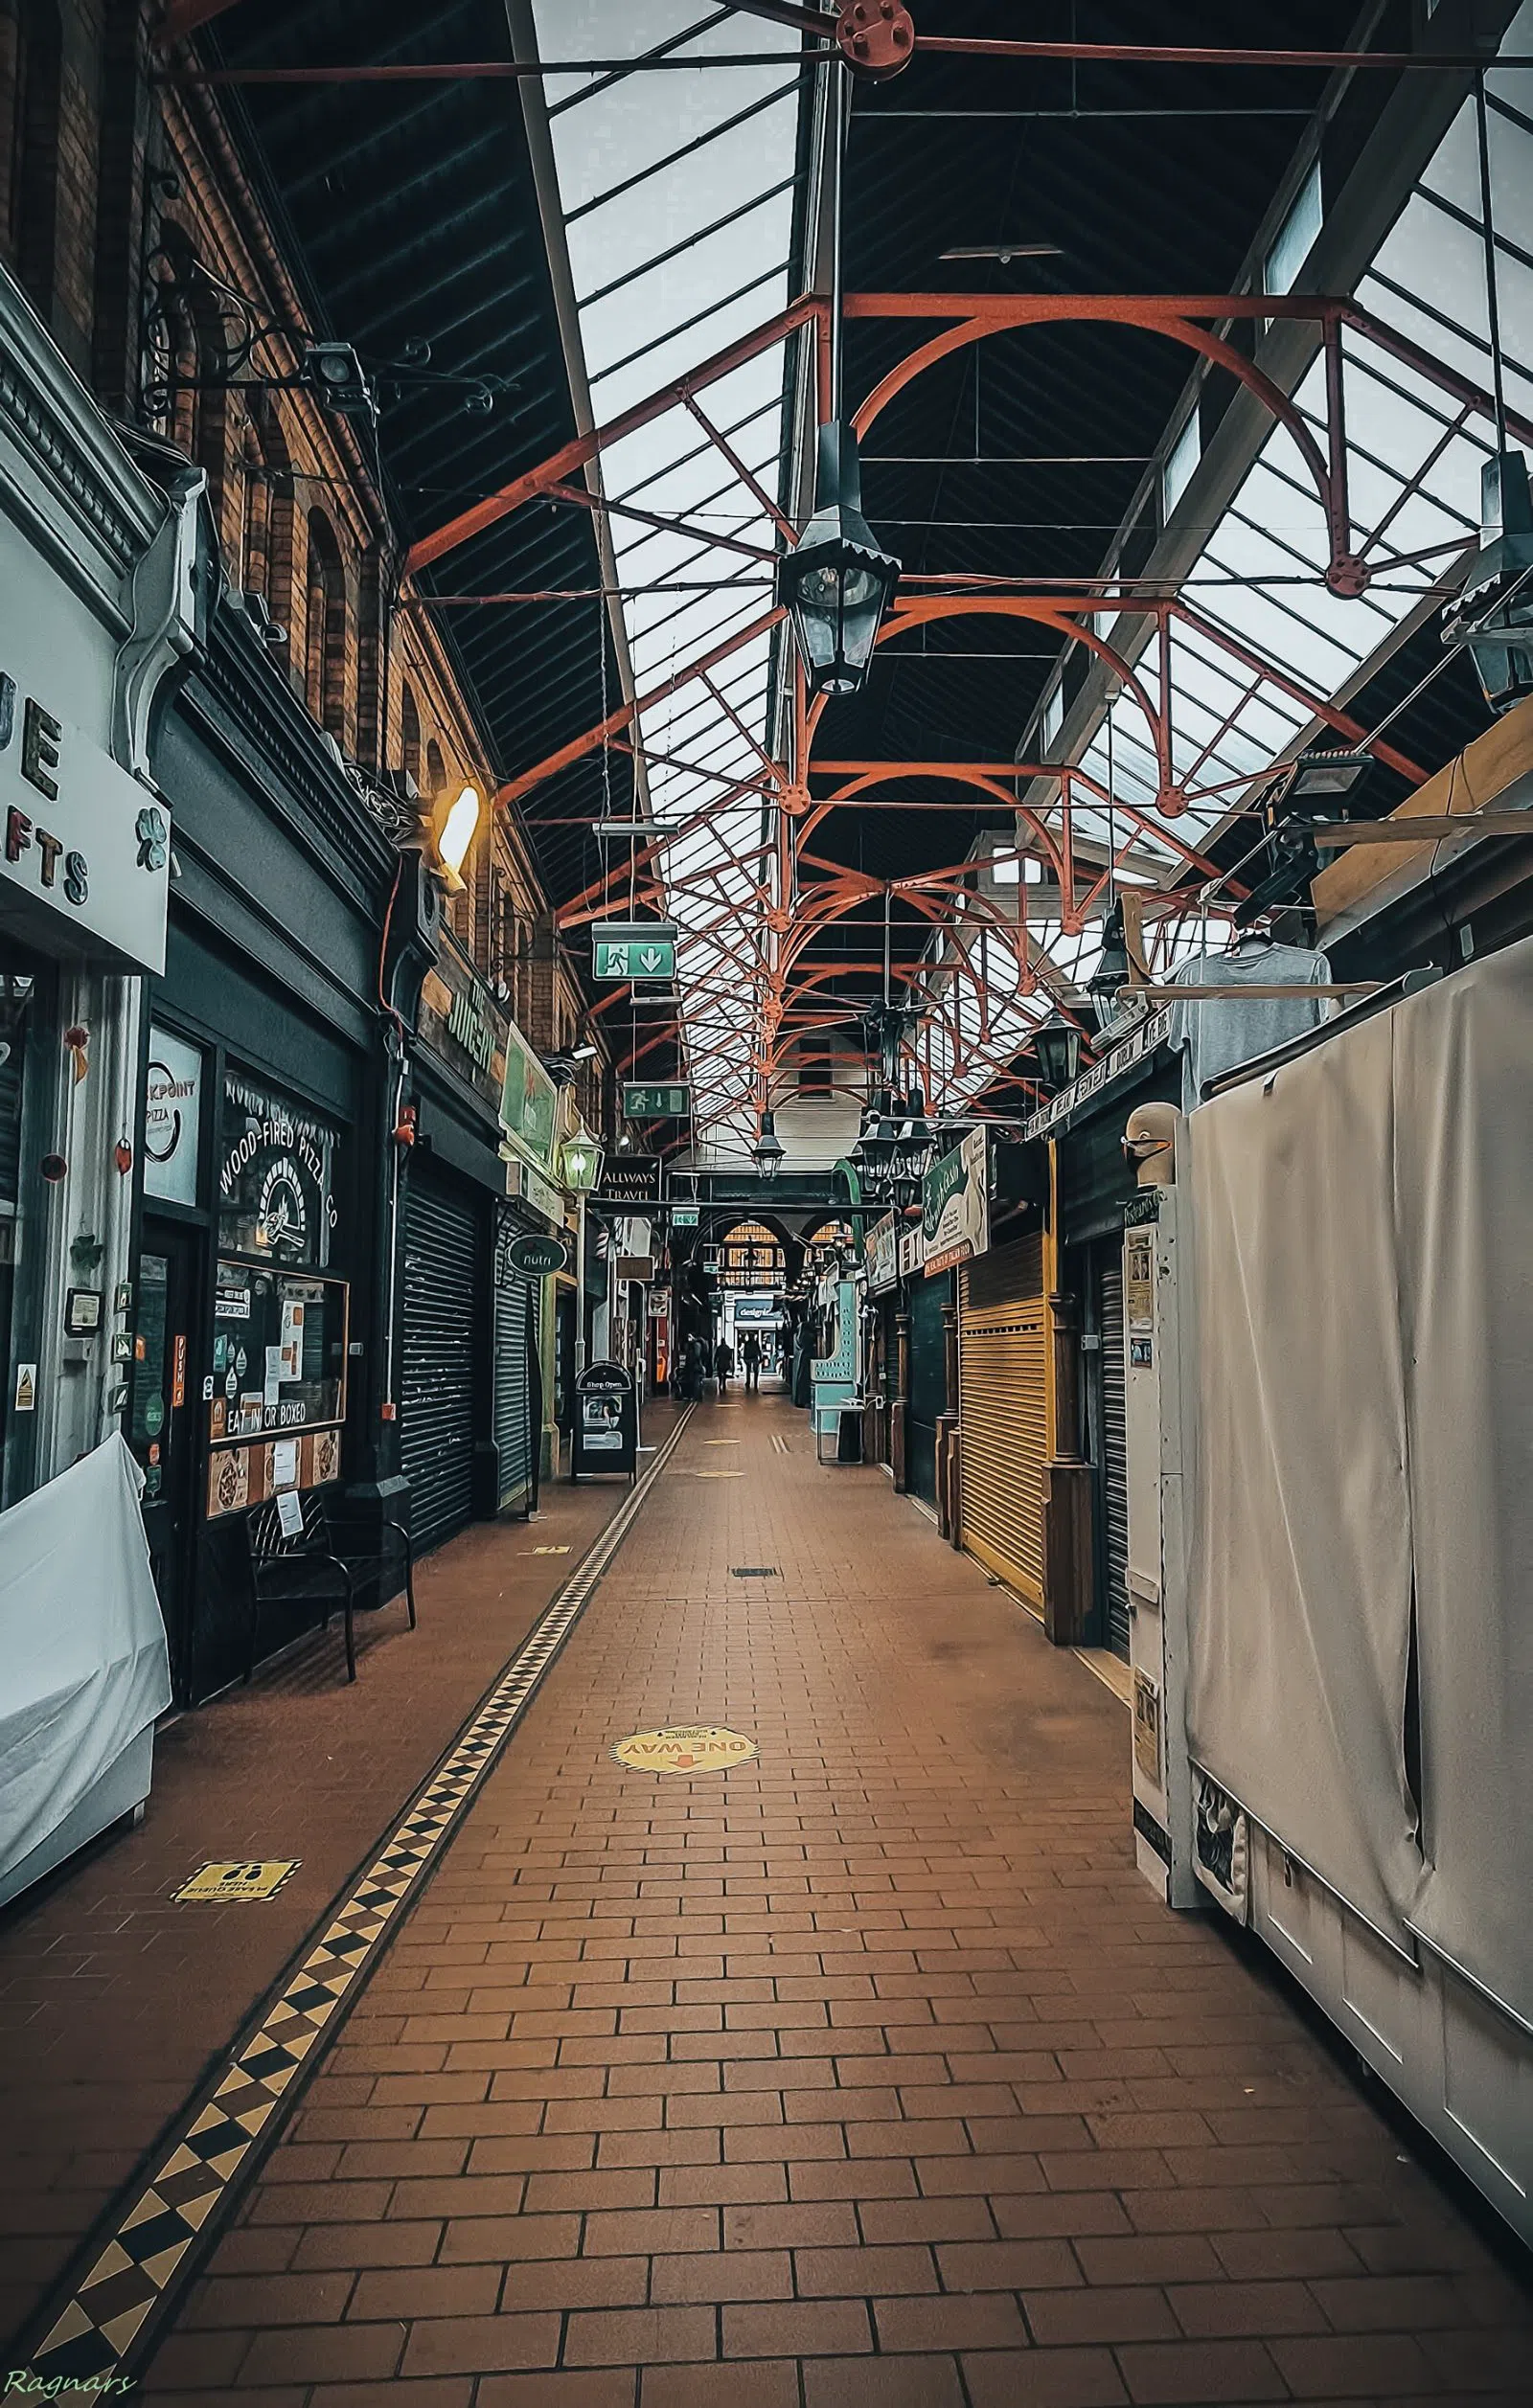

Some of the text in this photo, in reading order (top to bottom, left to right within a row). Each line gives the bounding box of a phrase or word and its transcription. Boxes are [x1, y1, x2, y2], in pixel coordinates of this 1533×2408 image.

[0, 805, 88, 904] FTS
[219, 1121, 338, 1229] WOOD-FIRED PIZZA CO
[603, 1171, 656, 1184] ALLWAYS
[523, 1254, 552, 1266] nutri
[177, 1337, 186, 1382] PUSH
[586, 1381, 605, 1390] Shop
[227, 1409, 246, 1434] EAT
[250, 1406, 262, 1432] IN
[263, 1406, 277, 1428] OR
[280, 1402, 307, 1426] BOXED
[623, 1740, 747, 1754] ONE WAY
